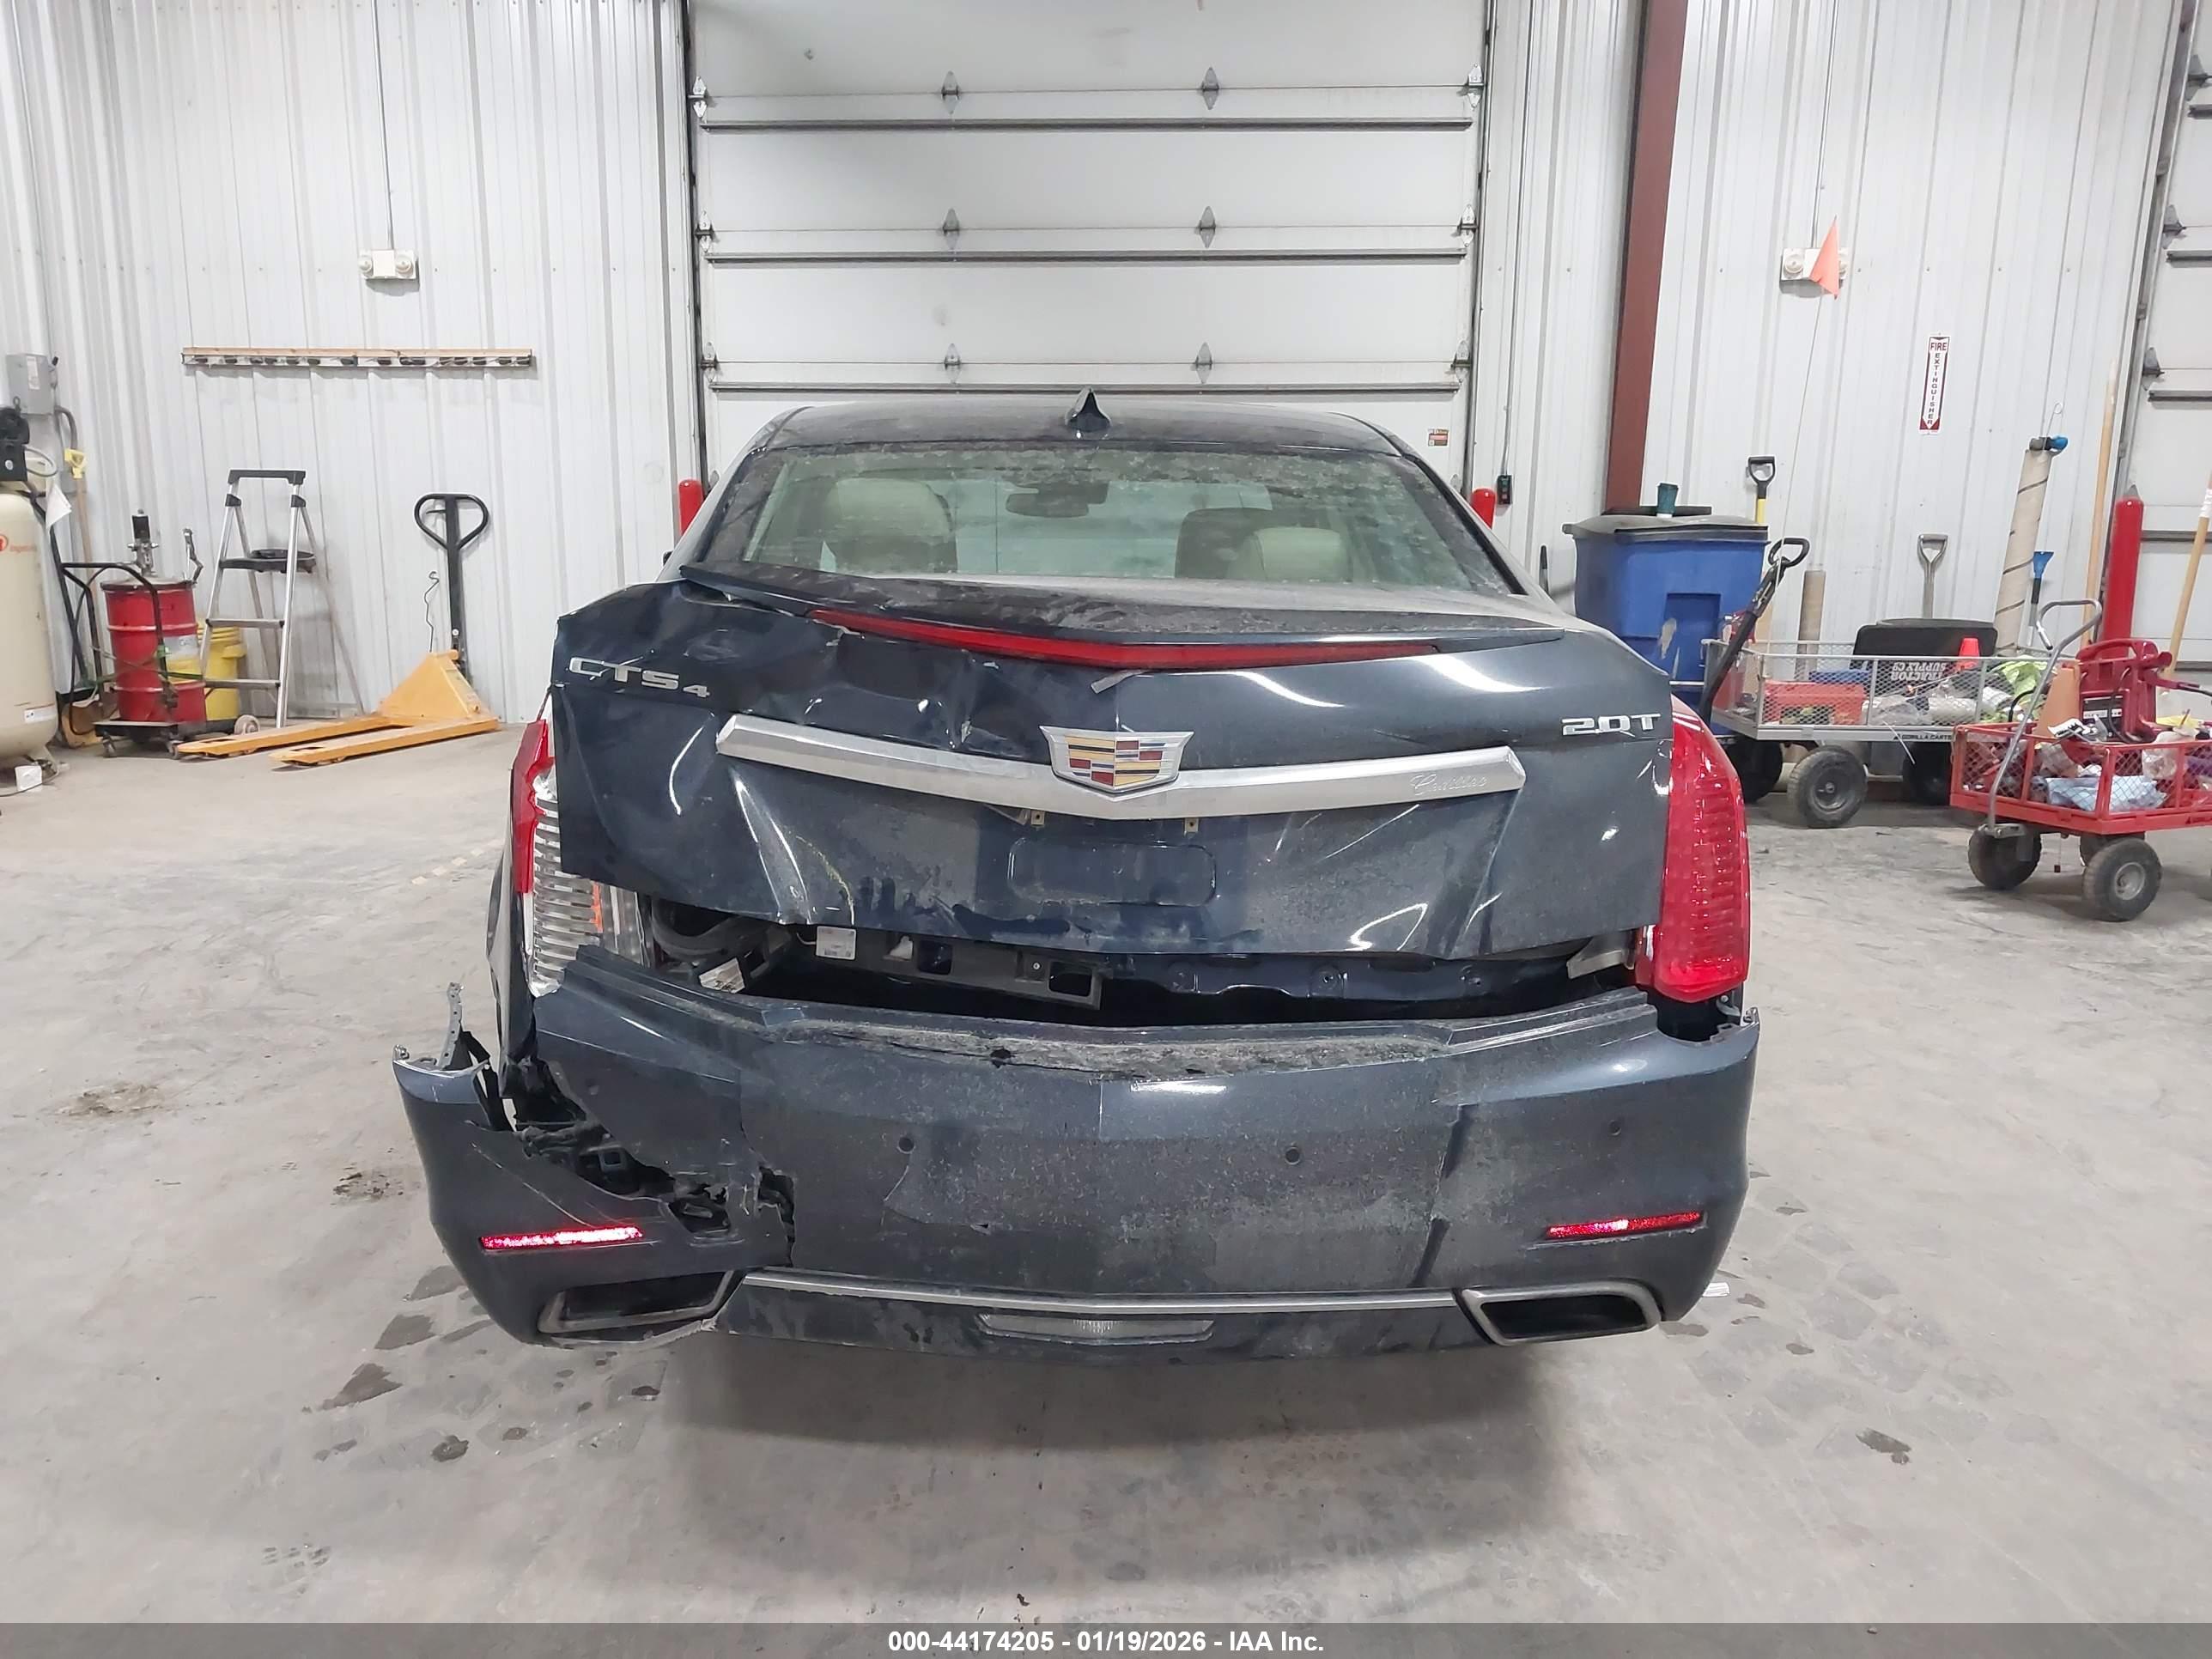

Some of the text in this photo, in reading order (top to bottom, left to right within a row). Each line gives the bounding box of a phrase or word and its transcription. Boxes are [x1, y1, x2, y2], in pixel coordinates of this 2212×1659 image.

[1929, 342, 1948, 351] FIRE
[1927, 352, 1941, 425] EXTINGUISHER
[1906, 662, 1948, 672] SUPPLY
[1890, 672, 1943, 681] TRACTOR
